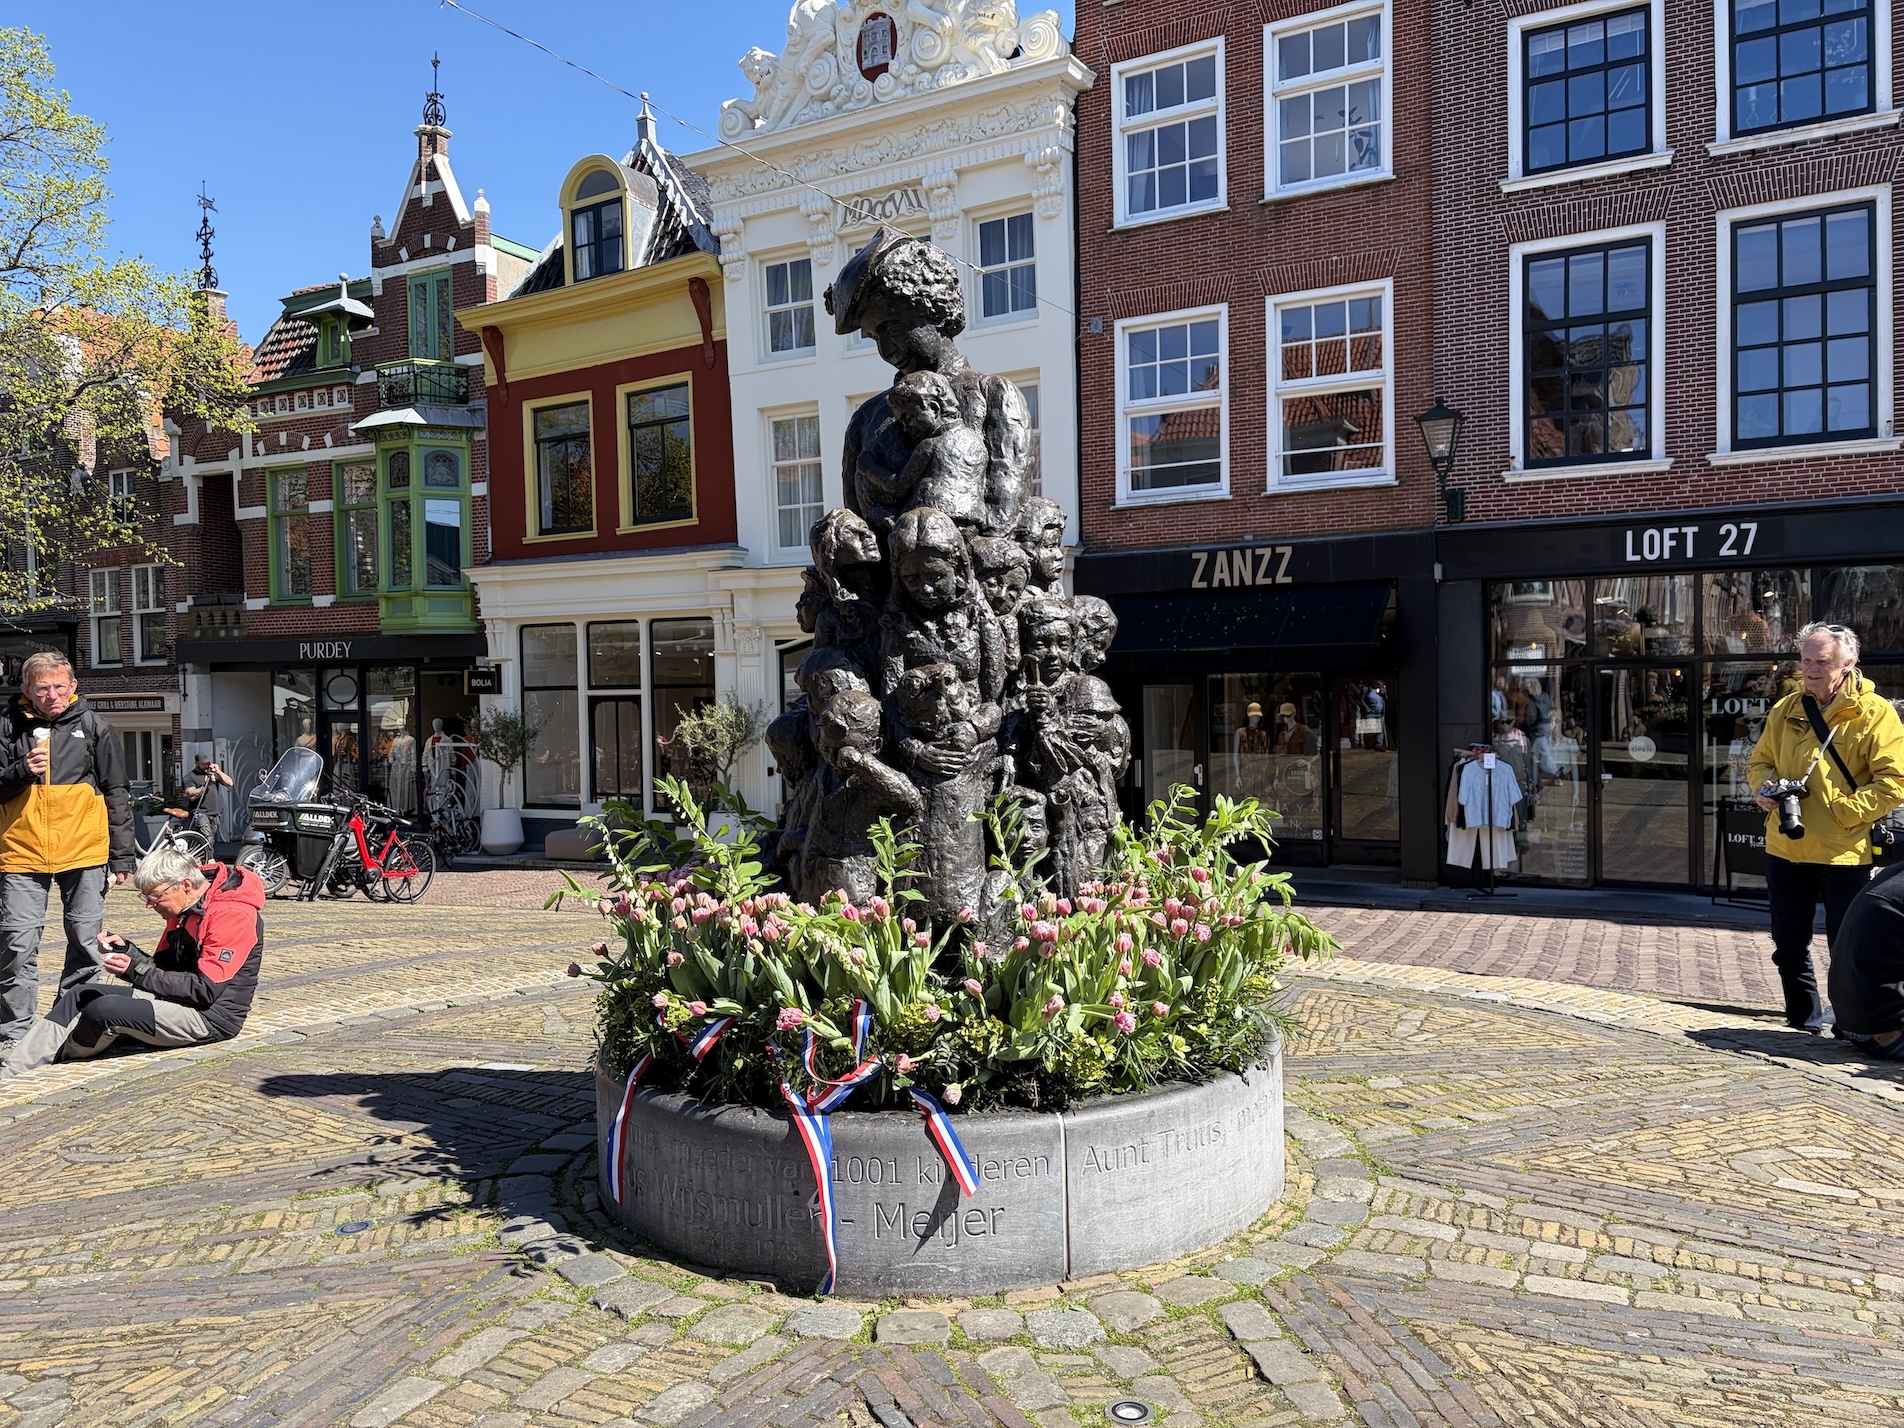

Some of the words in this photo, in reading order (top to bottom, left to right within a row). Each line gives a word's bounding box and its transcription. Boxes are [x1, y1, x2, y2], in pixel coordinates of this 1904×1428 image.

[841, 189, 926, 227] MDCCVII
[1626, 525, 1699, 562] LOFT
[1718, 522, 1758, 557] 27
[1191, 546, 1293, 589] ZANZZ
[299, 641, 352, 660] PURDEY
[470, 678, 493, 688] BOLIA
[97, 700, 110, 709] GRILL
[114, 700, 138, 709] BIERSTUBE
[138, 699, 161, 709] ALKMAAR
[1711, 697, 1771, 715] LOFT
[1631, 745, 1653, 753] OPEN
[254, 810, 278, 819] ALLDEK
[302, 812, 335, 824] ALLDEK
[1727, 832, 1756, 844] LOFT
[1757, 835, 1766, 845] 2
[1080, 1136, 1150, 1176] Aunt
[1157, 1120, 1227, 1160] Truus,
[831, 1156, 902, 1185] 1001
[873, 1202, 1006, 1251] Meijer
